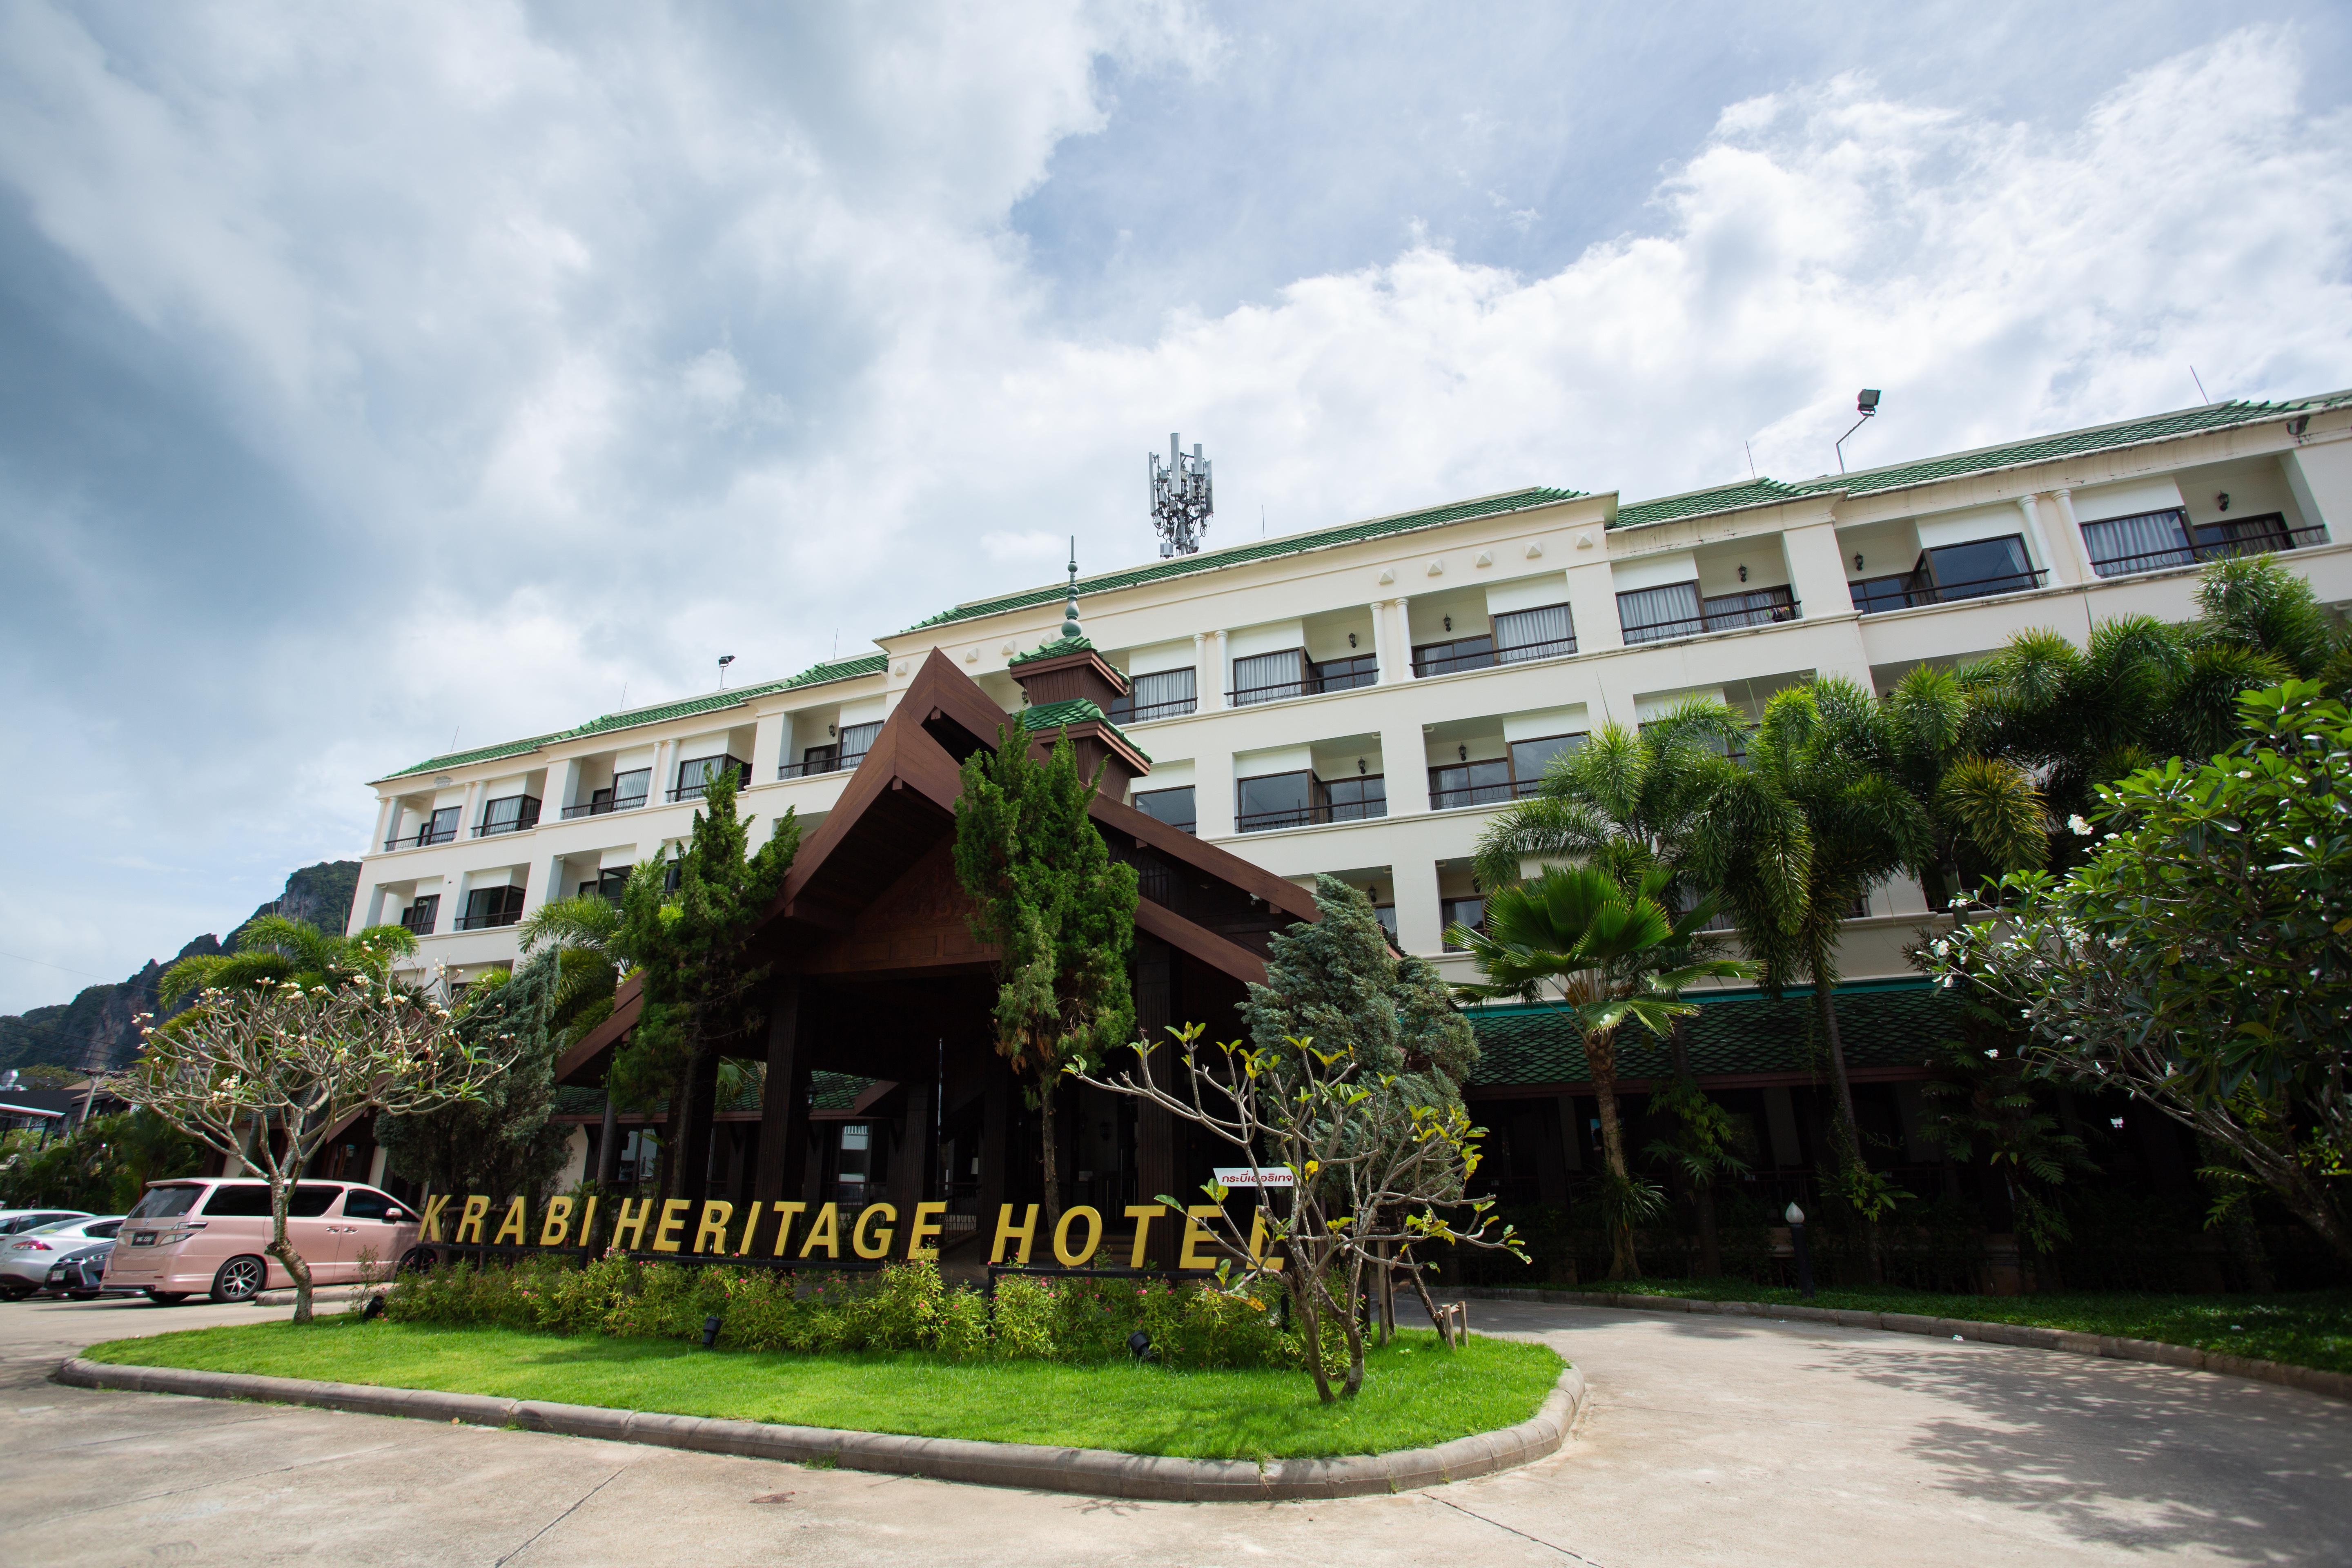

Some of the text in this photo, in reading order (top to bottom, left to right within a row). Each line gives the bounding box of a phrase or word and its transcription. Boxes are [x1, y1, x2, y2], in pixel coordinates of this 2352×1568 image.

[417, 1195, 1284, 1269] KRABI HERITAGE HOTEL
